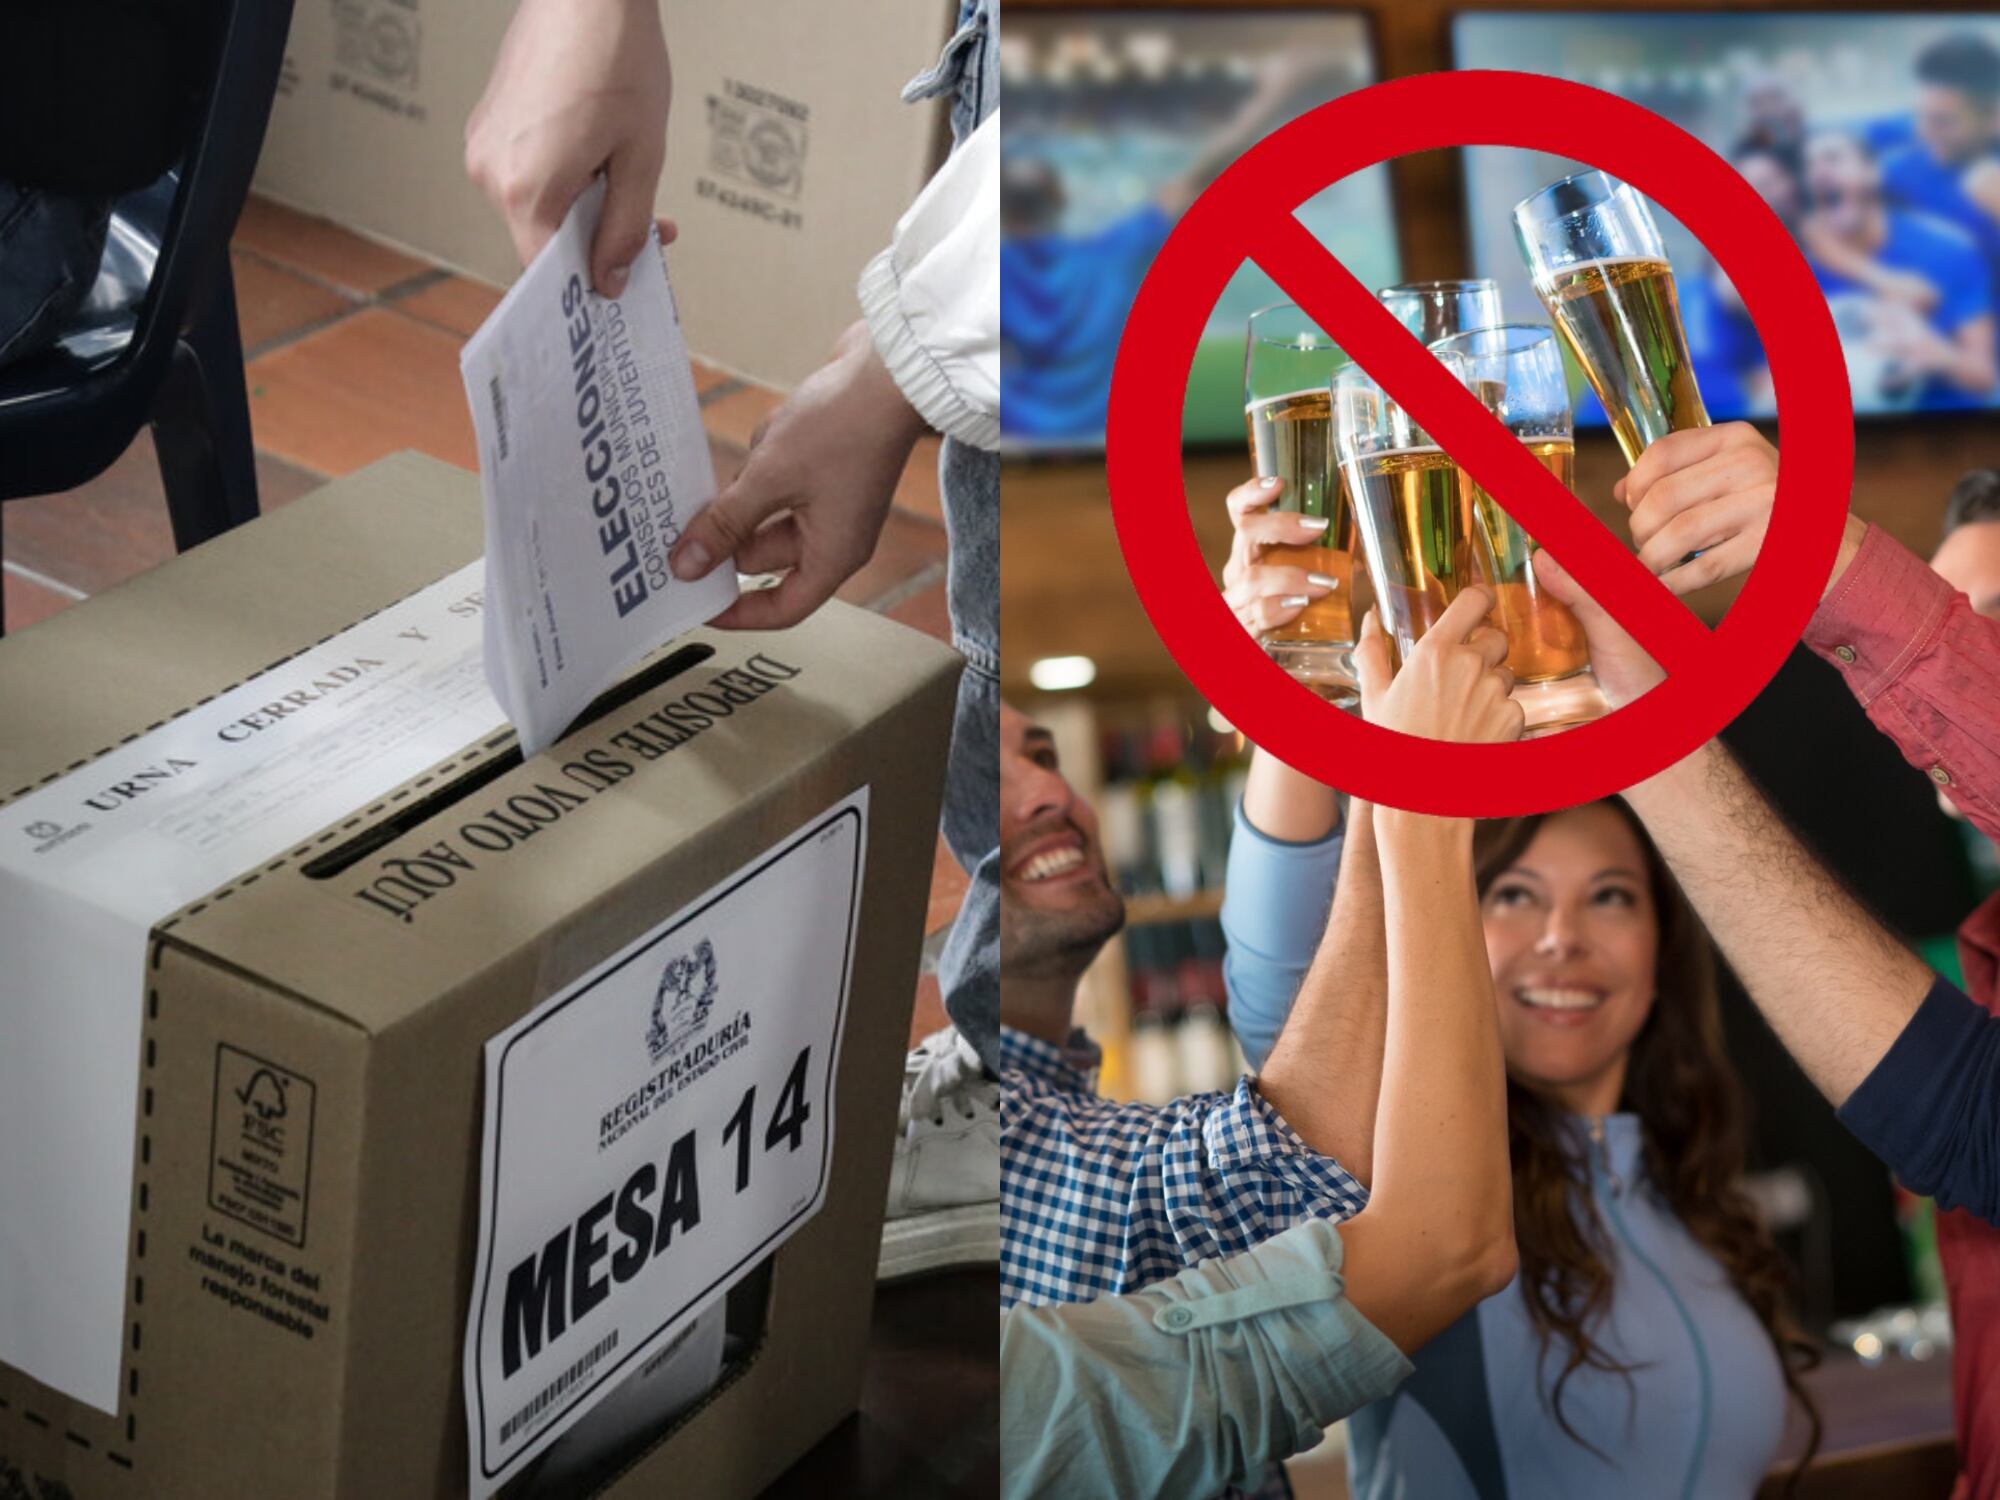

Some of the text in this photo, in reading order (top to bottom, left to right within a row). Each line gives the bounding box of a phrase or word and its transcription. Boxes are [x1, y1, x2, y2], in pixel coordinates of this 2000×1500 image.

[562, 273, 649, 619] ELECCIONES
[606, 302, 682, 549] CALES DE JUVENTUD
[619, 463, 669, 592] CONSEJOS
[83, 755, 199, 812] URNA
[217, 655, 385, 744] CERRADA
[398, 627, 431, 645] Y
[614, 652, 803, 762] DEPOSITE
[459, 782, 591, 852] VOTO
[561, 748, 637, 795] SU
[354, 840, 475, 924] AQUÍ
[598, 1035, 749, 1151] NACIONAL DEL ESTADO CIVIL
[600, 1010, 752, 1136] REGISTRADURÍA
[201, 1222, 322, 1294] La marca del
[502, 1045, 812, 1381] MESA 14
[188, 1243, 330, 1324] manejo forestal
[201, 1273, 315, 1339] responsable
